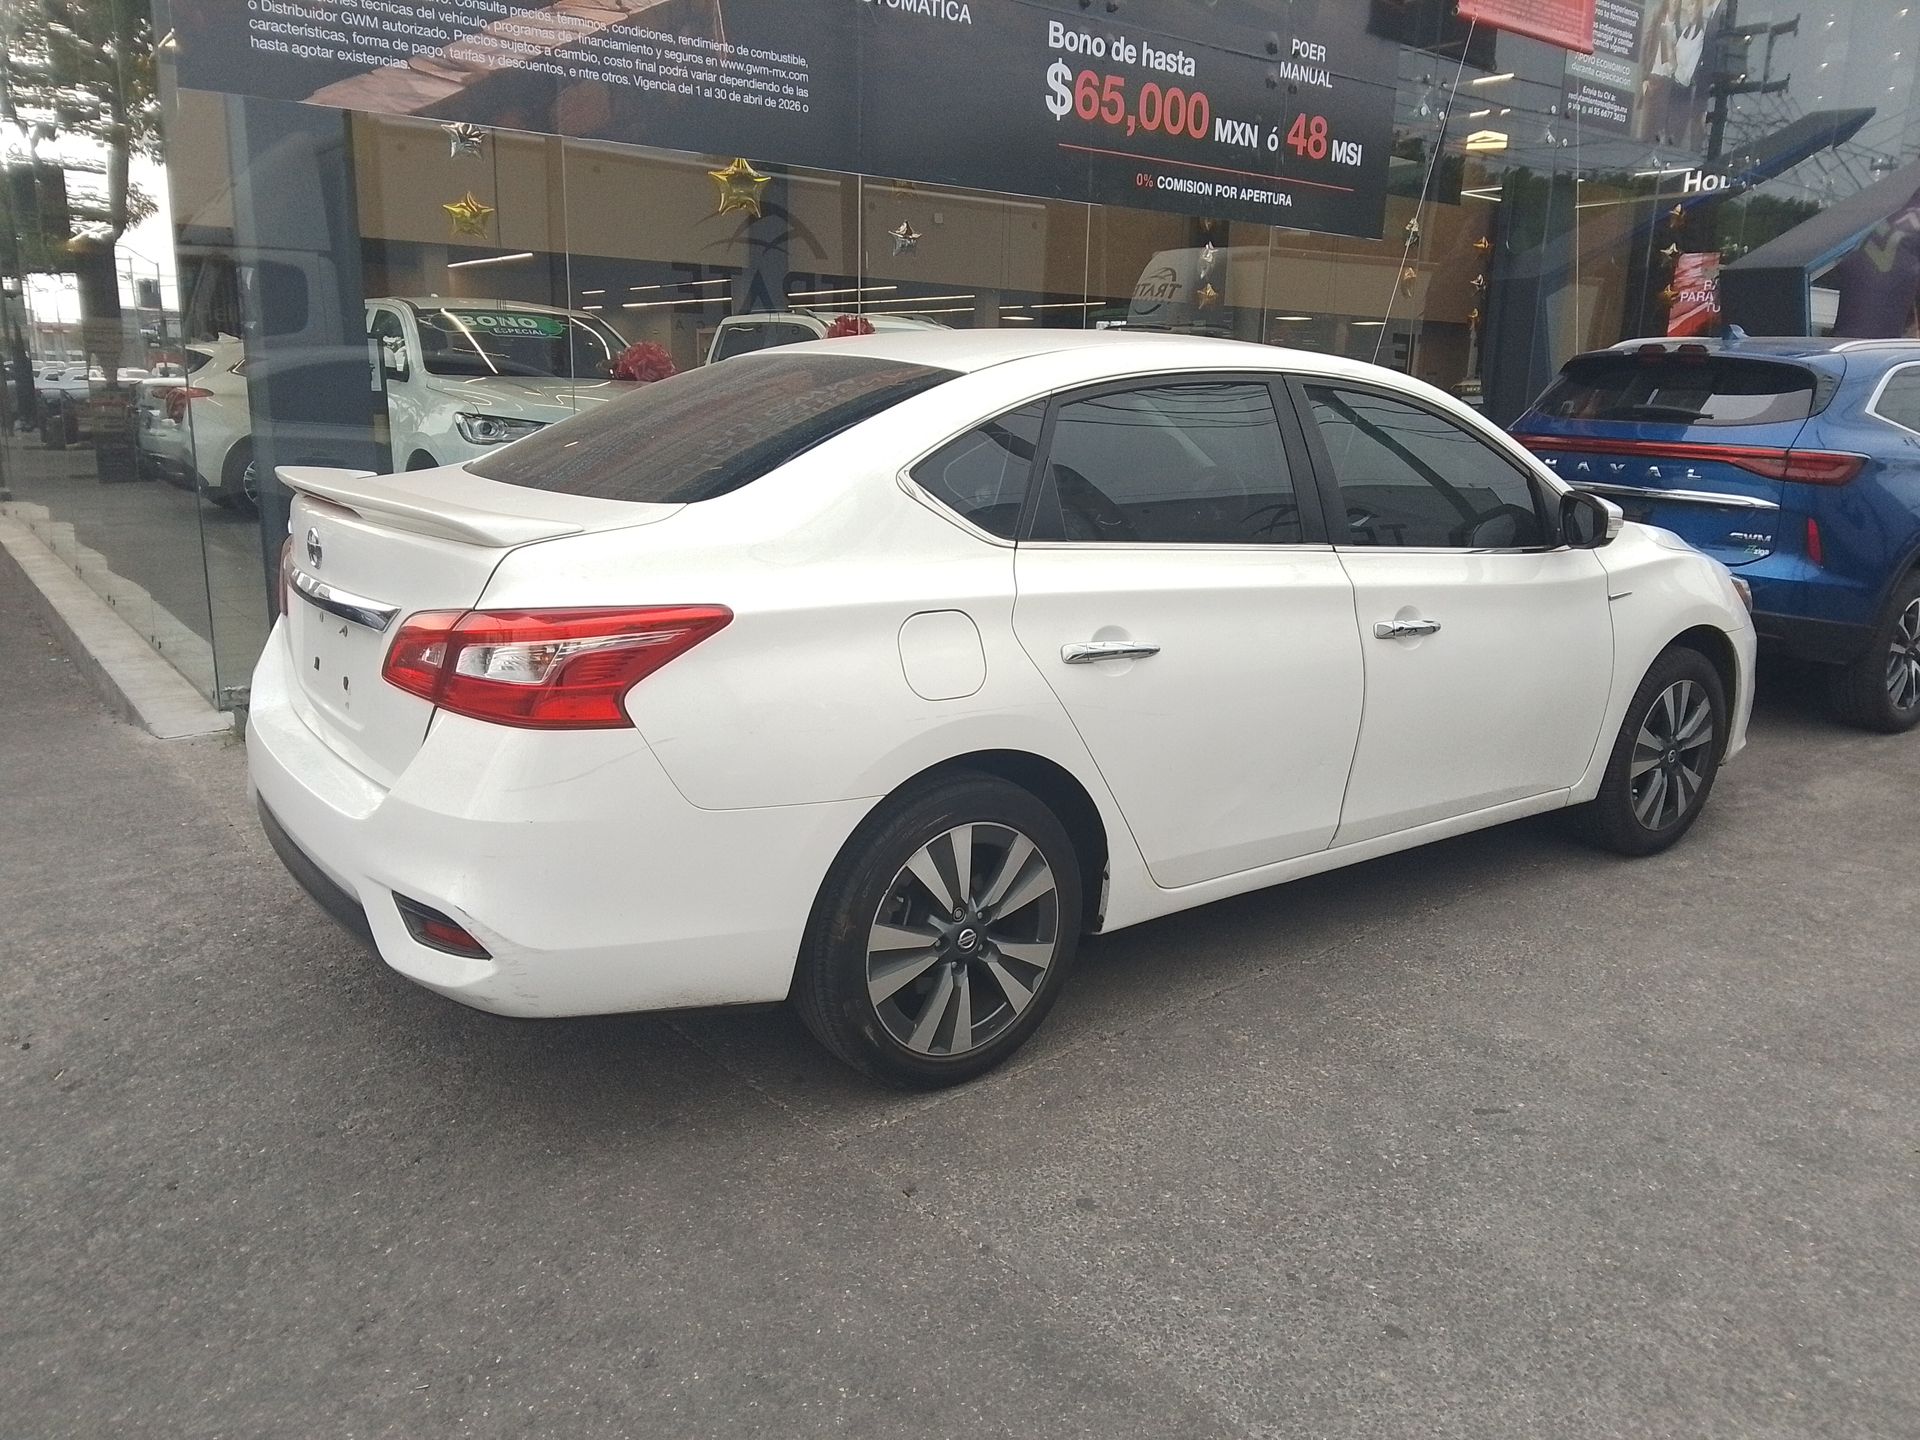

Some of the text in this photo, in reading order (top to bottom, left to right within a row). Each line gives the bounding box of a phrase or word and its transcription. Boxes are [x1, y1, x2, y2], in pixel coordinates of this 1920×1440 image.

[250, 35, 411, 70] hasta agotar existencias.
[261, 0, 337, 22] Distribuidor
[341, 11, 379, 28] GWM
[382, 19, 450, 40] autorizado.
[453, 29, 498, 48] Precios
[500, 39, 542, 56] sujetos
[544, 47, 551, 57] a
[554, 45, 600, 65] cambio,
[603, 55, 633, 69] costo
[635, 59, 656, 73] final
[659, 65, 688, 78] podrá
[690, 70, 717, 84] variar
[719, 73, 781, 94] dependiendo
[782, 83, 794, 95] de
[796, 85, 809, 98] las
[416, 6, 435, 20] del
[438, 11, 490, 29] vehículo,
[494, 20, 554, 40] programas
[558, 29, 572, 42] de
[578, 32, 653, 56] financiamiento
[656, 48, 662, 59] y
[664, 49, 703, 65] seguros
[705, 57, 717, 68] en
[720, 58, 809, 82] www.gwm-mx.com
[510, 6, 553, 23] precios,
[557, 12, 609, 33] términos,
[611, 23, 676, 45] condiciones,
[678, 33, 735, 54] rendimiento
[736, 44, 749, 56] de
[751, 49, 809, 69] combustible,
[1048, 20, 1196, 77] Bono de hasta
[1291, 38, 1327, 63] POER
[249, 18, 348, 44] características,
[352, 31, 389, 49] forma
[392, 38, 409, 51] de
[411, 43, 446, 59] pago,
[449, 48, 485, 64] tarifas
[488, 55, 496, 67] y
[497, 54, 567, 77] descuentos,
[601, 72, 631, 86] otros.
[633, 75, 676, 92] Vigencia
[678, 83, 693, 96] del
[696, 85, 701, 96] 1
[704, 87, 712, 98] al
[714, 88, 726, 100] 30
[729, 91, 741, 102] de
[743, 93, 762, 107] abril
[764, 96, 776, 108] de
[778, 98, 800, 112] 2026
[802, 104, 809, 113] o
[1279, 61, 1333, 89] MANUAL
[1045, 57, 1363, 167] $65,000 MXN ó 48 MSI
[1136, 173, 1293, 207] 0% COMISION POR APERTURA
[1680, 291, 1714, 302] PARA
[459, 316, 538, 329] BONO
[493, 327, 547, 336] ESPECIAL
[1544, 458, 1702, 480] HAVAL
